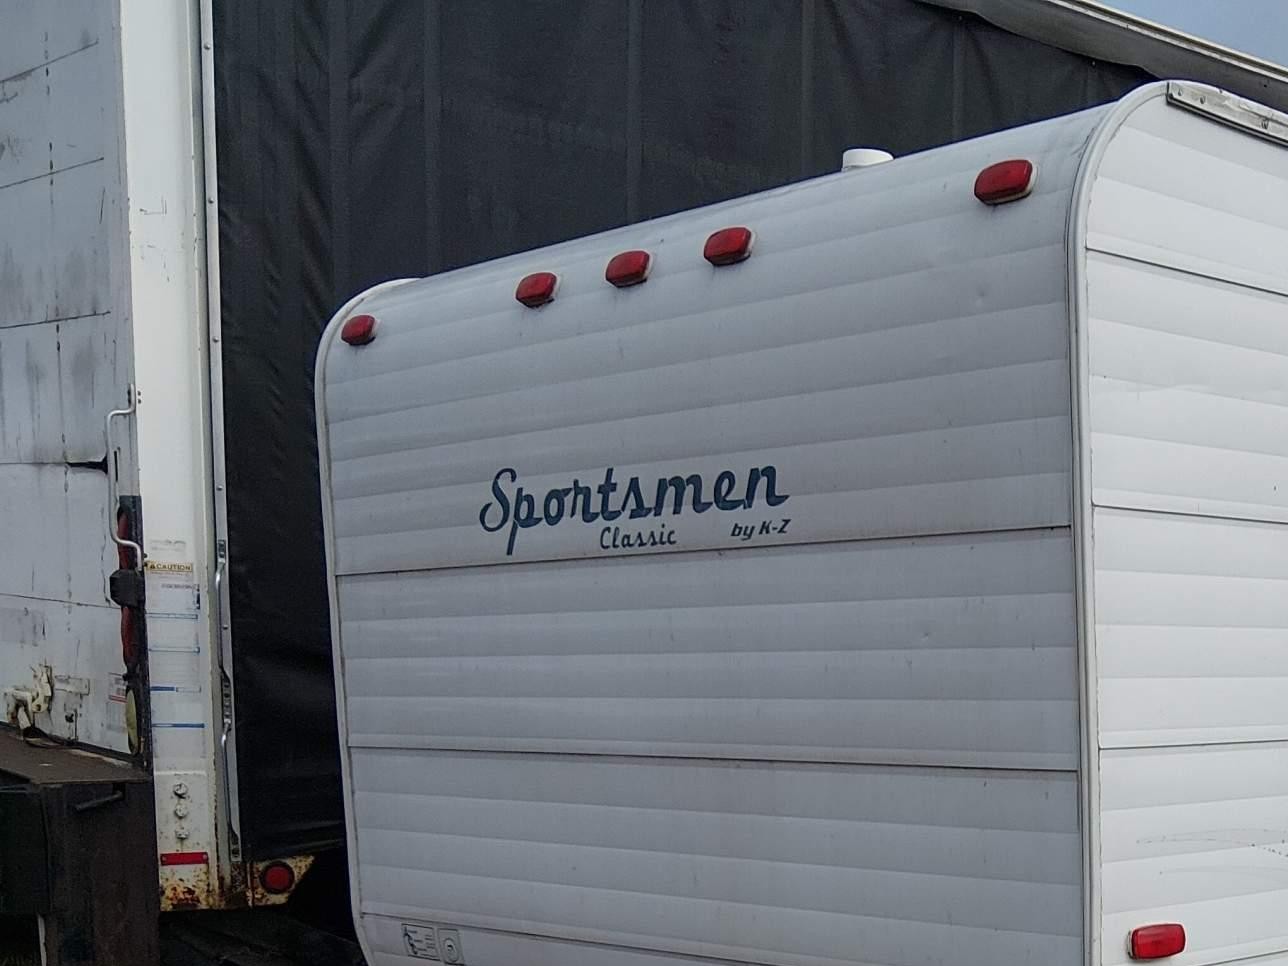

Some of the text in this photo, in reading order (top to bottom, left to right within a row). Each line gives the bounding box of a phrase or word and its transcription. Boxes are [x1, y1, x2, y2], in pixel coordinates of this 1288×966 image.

[479, 465, 790, 556] Sportsmen
[600, 524, 677, 549] Classic
[730, 519, 791, 541] by K-Z
[156, 563, 191, 571] CAUTION
